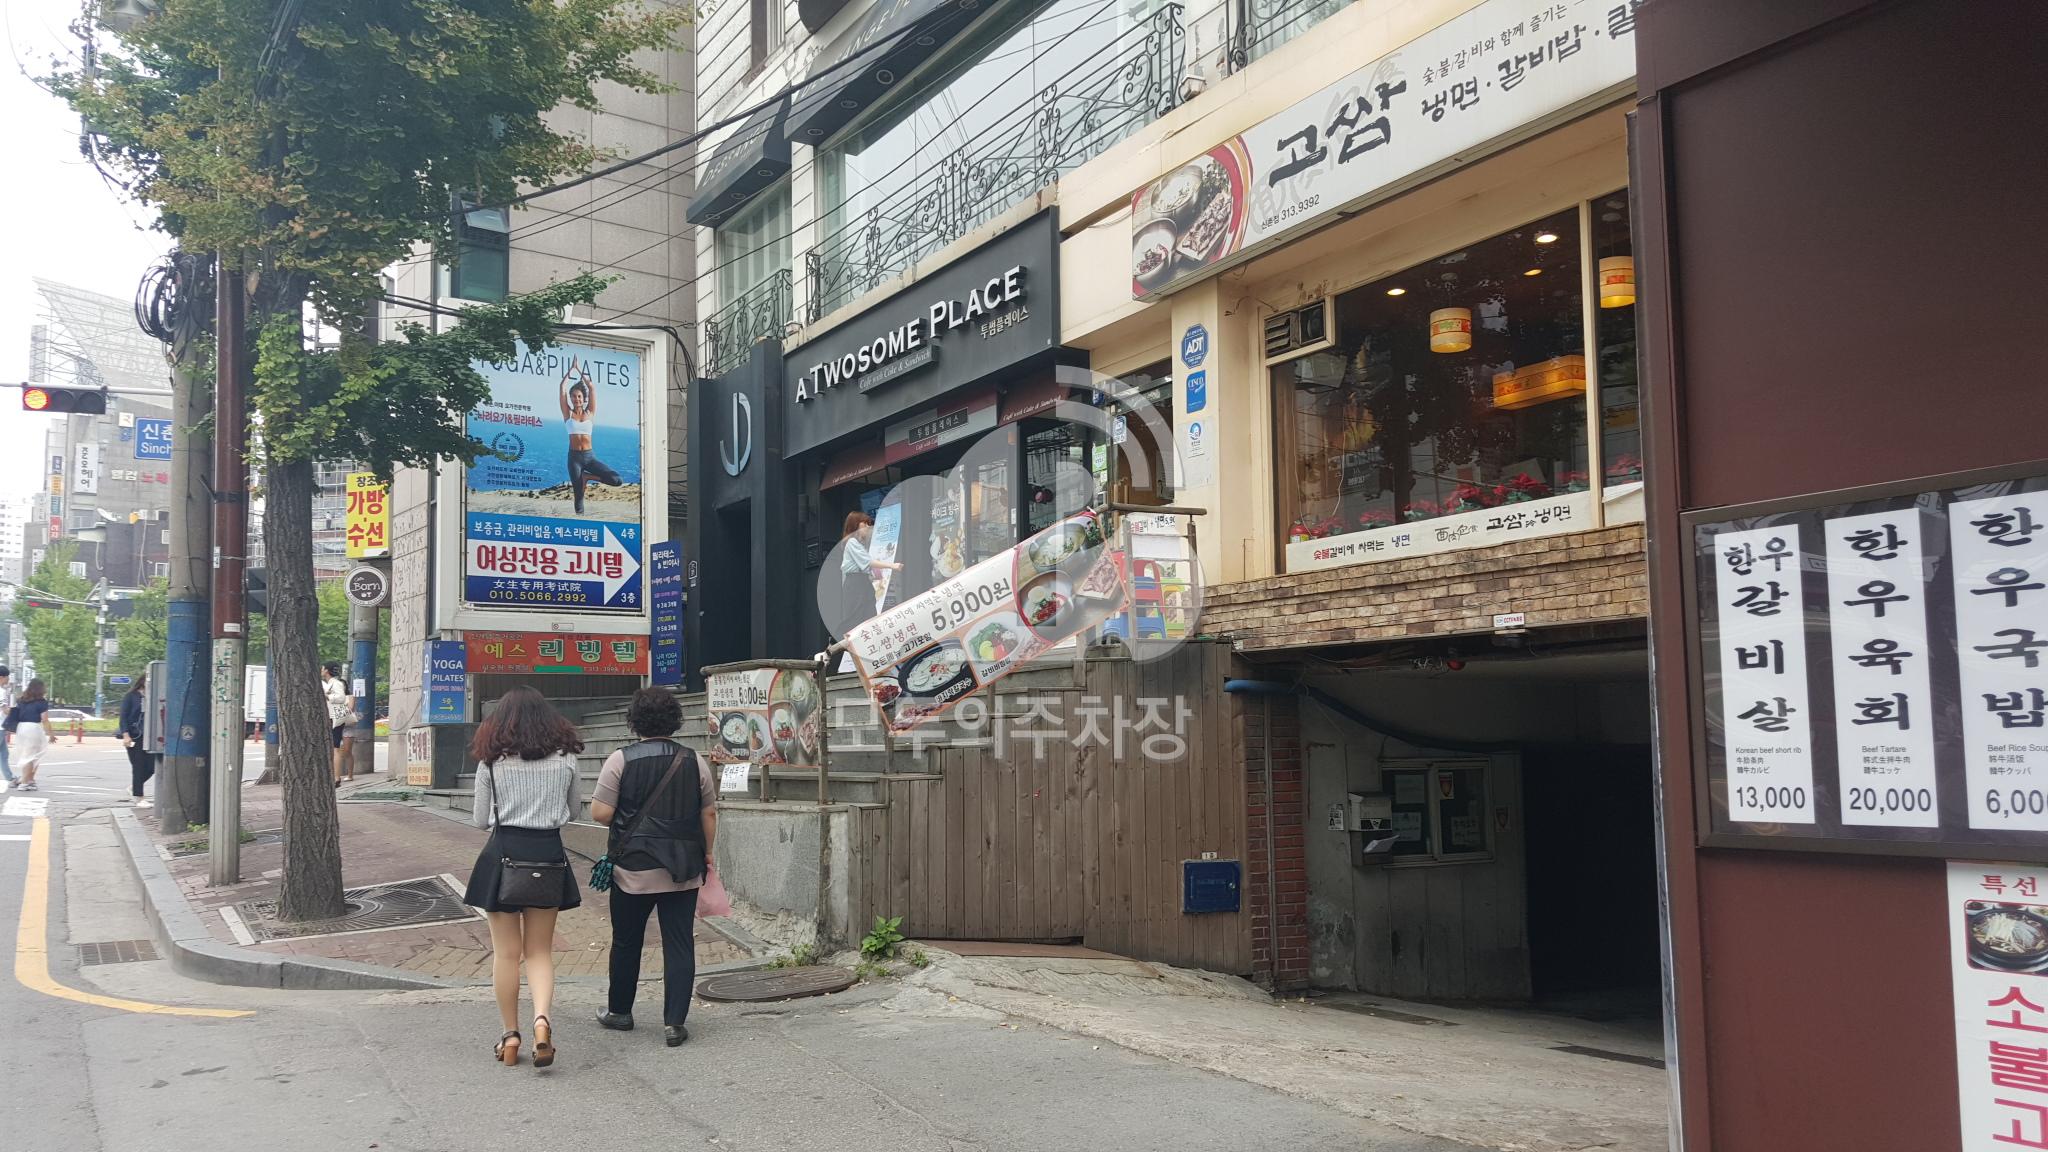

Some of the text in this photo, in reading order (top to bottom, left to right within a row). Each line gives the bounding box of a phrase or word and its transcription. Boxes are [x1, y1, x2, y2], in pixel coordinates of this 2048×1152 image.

[1500, 22, 1525, 47] 함께
[1529, 4, 1568, 33] 즐기는
[1421, 76, 1481, 123] 냉면
[1268, 79, 1408, 189] 고쌈
[1261, 216, 1280, 231] 신촌점
[795, 265, 1023, 403] A TWOSOME PLACE
[979, 305, 1030, 339] 투썸플레이스
[1186, 336, 1204, 357] ADT
[916, 414, 960, 438] 투썸플레이스
[347, 490, 386, 515] 가방
[1486, 512, 1526, 531] 고쌈
[1534, 504, 1572, 524] 냉면
[348, 521, 385, 547] 수선
[620, 527, 636, 540] 4층
[1391, 533, 1411, 548] 냉면
[476, 544, 624, 579] 여성전용 고시텔
[1723, 537, 1794, 576] 한우
[489, 589, 587, 603] 010.5066.2992
[620, 592, 636, 604] 3층
[931, 578, 1013, 631] 5,900원
[1843, 523, 1914, 731] 한우육회
[1969, 506, 2048, 729] 한우국밥
[484, 639, 637, 663] 예스 리빙텔
[1731, 580, 1797, 733] 갈비살
[433, 659, 464, 670] YOGA
[431, 674, 464, 682] PILATES
[1735, 747, 1758, 755] Korean
[1987, 744, 2006, 752] Beef
[2008, 744, 2027, 752] Rice
[1736, 786, 1806, 812] 13,000
[1849, 787, 1932, 815] 20,000
[1986, 789, 2048, 819] 6,00
[1980, 874, 2040, 897] 특선
